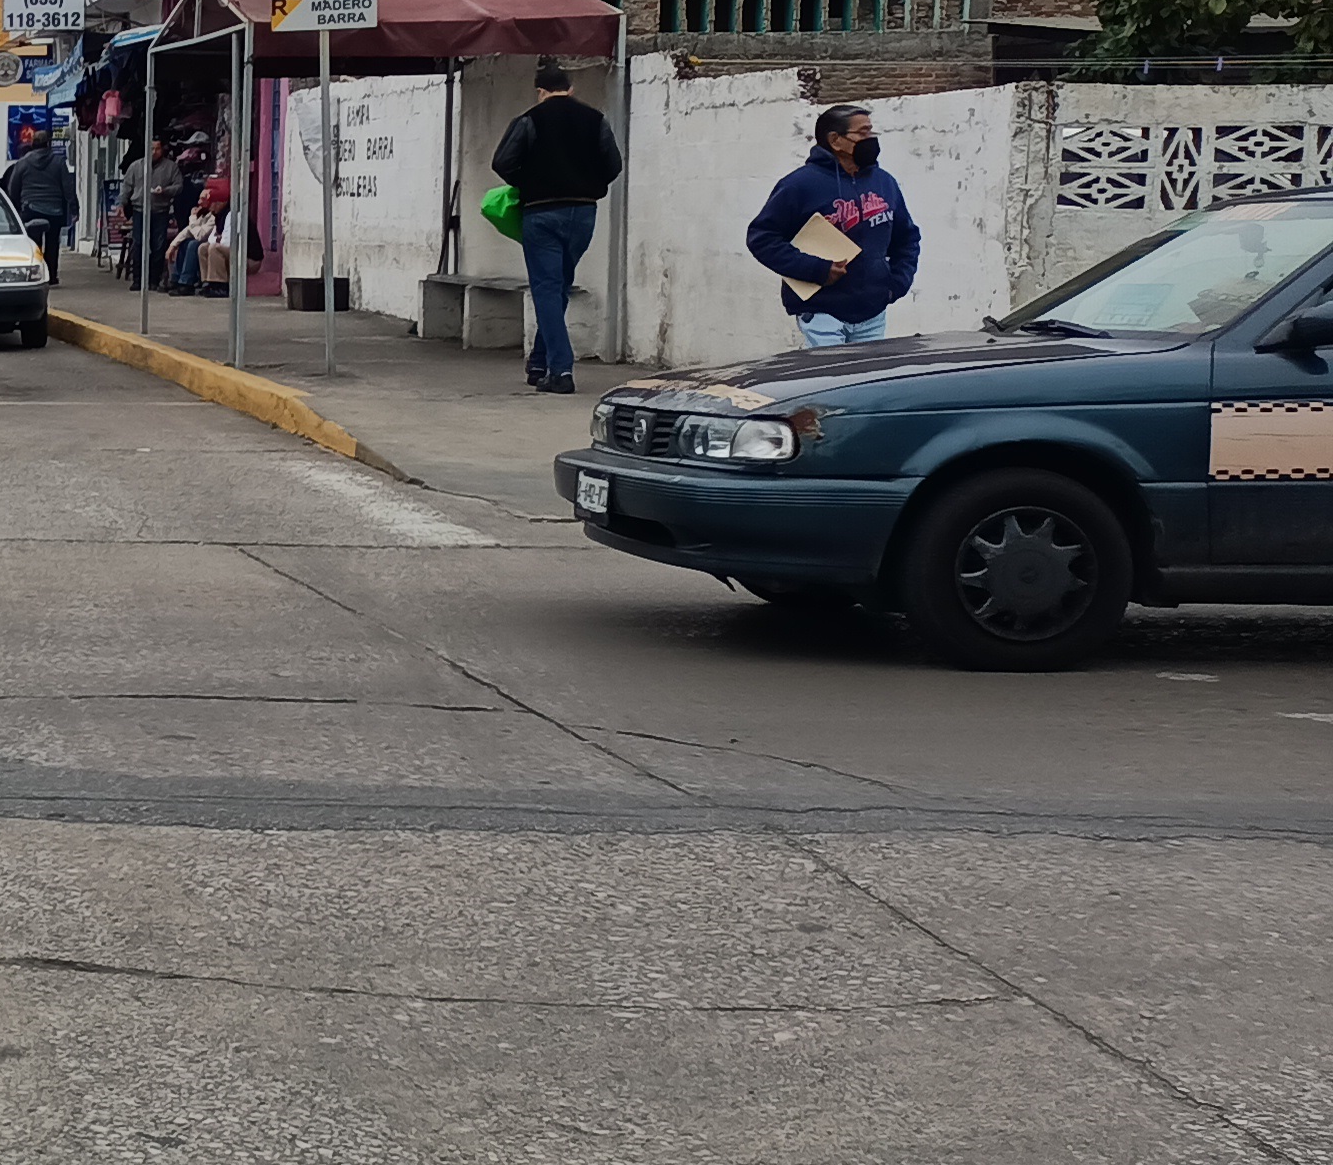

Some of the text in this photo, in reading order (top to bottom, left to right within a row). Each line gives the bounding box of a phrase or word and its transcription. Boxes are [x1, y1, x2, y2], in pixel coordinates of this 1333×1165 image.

[272, 0, 288, 16] R
[6, 11, 81, 28] 118-3612
[317, 12, 367, 25] BARRA
[367, 136, 393, 160] BARRA
